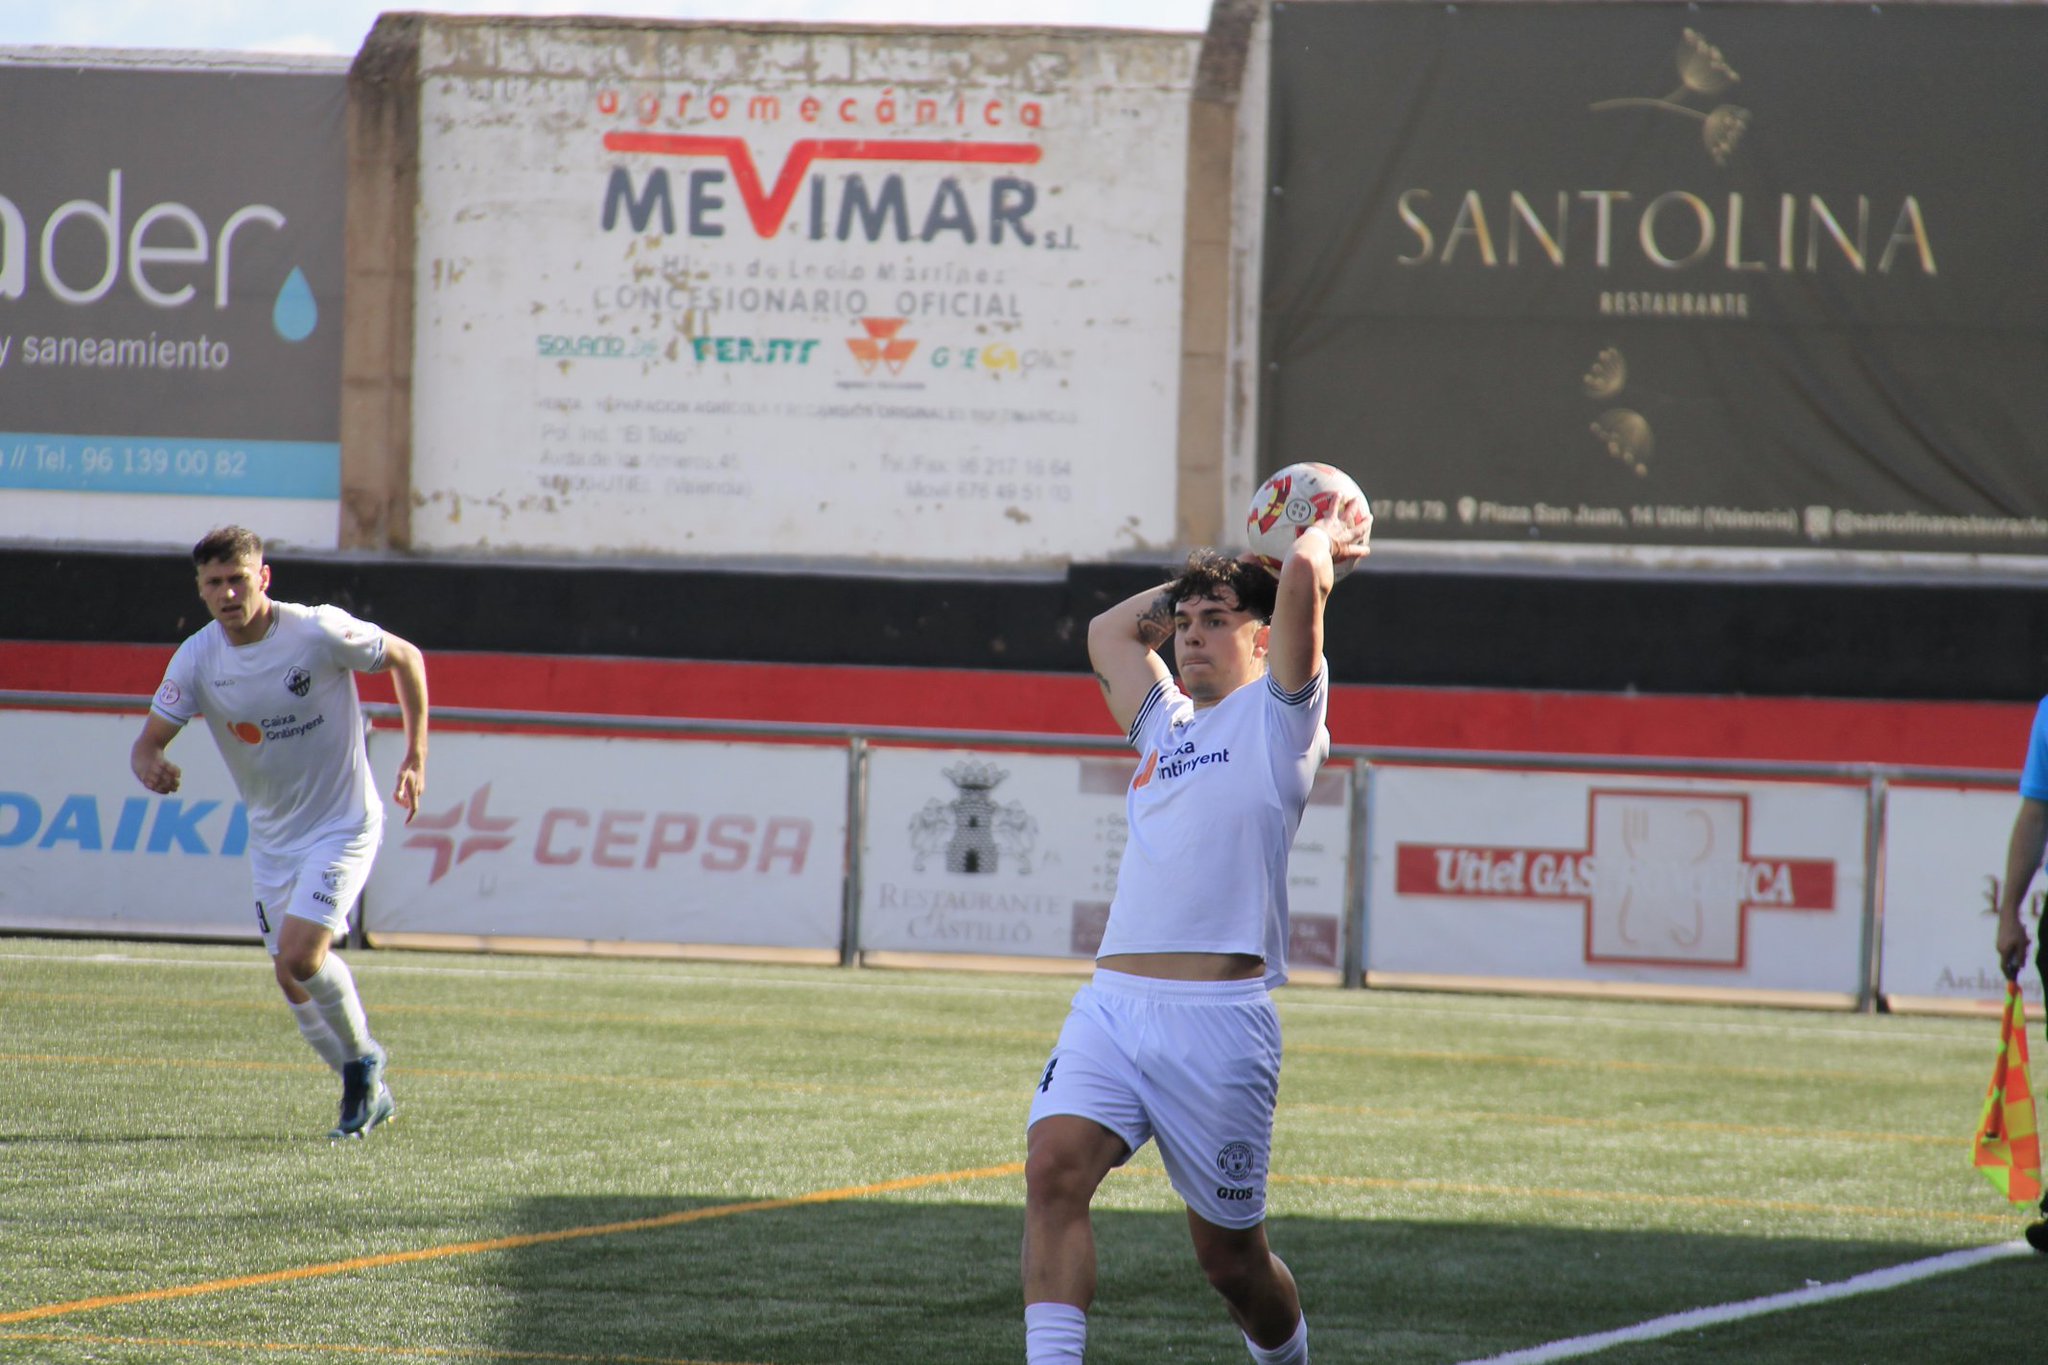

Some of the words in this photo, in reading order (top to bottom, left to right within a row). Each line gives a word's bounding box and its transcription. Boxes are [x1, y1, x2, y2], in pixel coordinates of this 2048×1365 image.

[602, 142, 1036, 246] MEVIMAR
[1397, 188, 1936, 276] SANTOLINA
[593, 284, 868, 316] CONCESIONARIO
[896, 289, 1022, 318] OFICIAL
[1600, 290, 1748, 317] RESTAURANTE
[22, 331, 230, 370] saneamiento
[81, 447, 113, 473] 96
[123, 447, 168, 475] 139
[176, 449, 208, 475] 00
[215, 450, 247, 476] 82
[1479, 501, 1531, 525] Plaza
[1534, 502, 1572, 525] San
[261, 713, 297, 729] Caixa
[266, 714, 325, 741] Ontinyent
[1157, 748, 1230, 780] ntinyent
[0, 791, 250, 858] DAIKI
[533, 806, 815, 876] CEPSA
[1435, 848, 1525, 893] Utiel
[1217, 1186, 1254, 1200] GIOS
